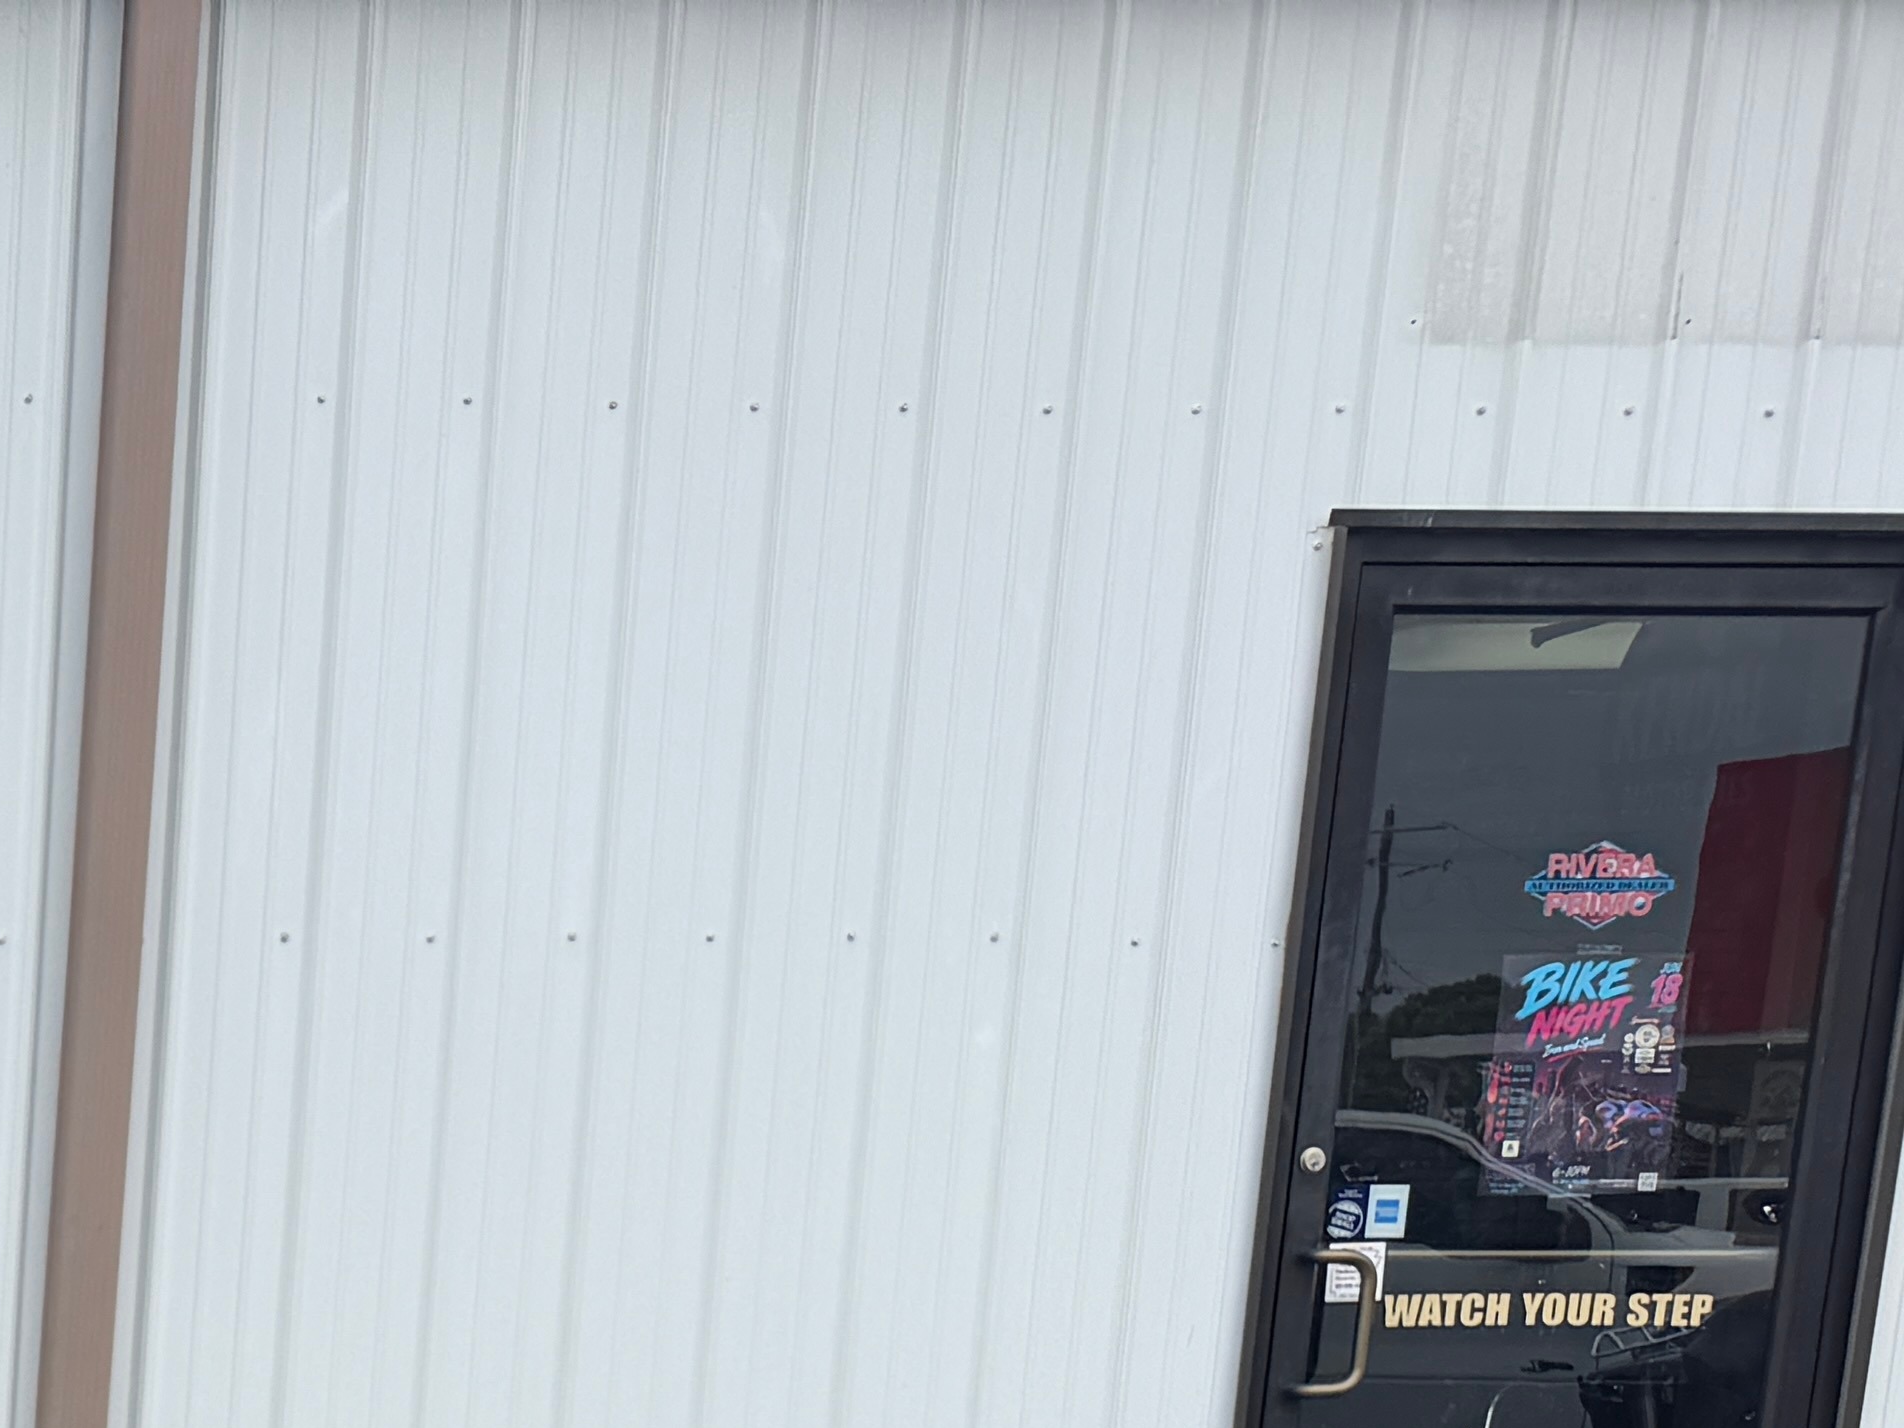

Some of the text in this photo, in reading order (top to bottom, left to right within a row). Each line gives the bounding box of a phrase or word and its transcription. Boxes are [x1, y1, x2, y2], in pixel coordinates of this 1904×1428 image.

[1547, 852, 1657, 879] RIVERA
[1543, 892, 1654, 917] PRIMO
[1514, 957, 1641, 1020] BIKE
[1650, 973, 1684, 1008] 18
[1524, 995, 1634, 1048] NIGHT
[1384, 1292, 1714, 1328] WATCH YOUR STEP
